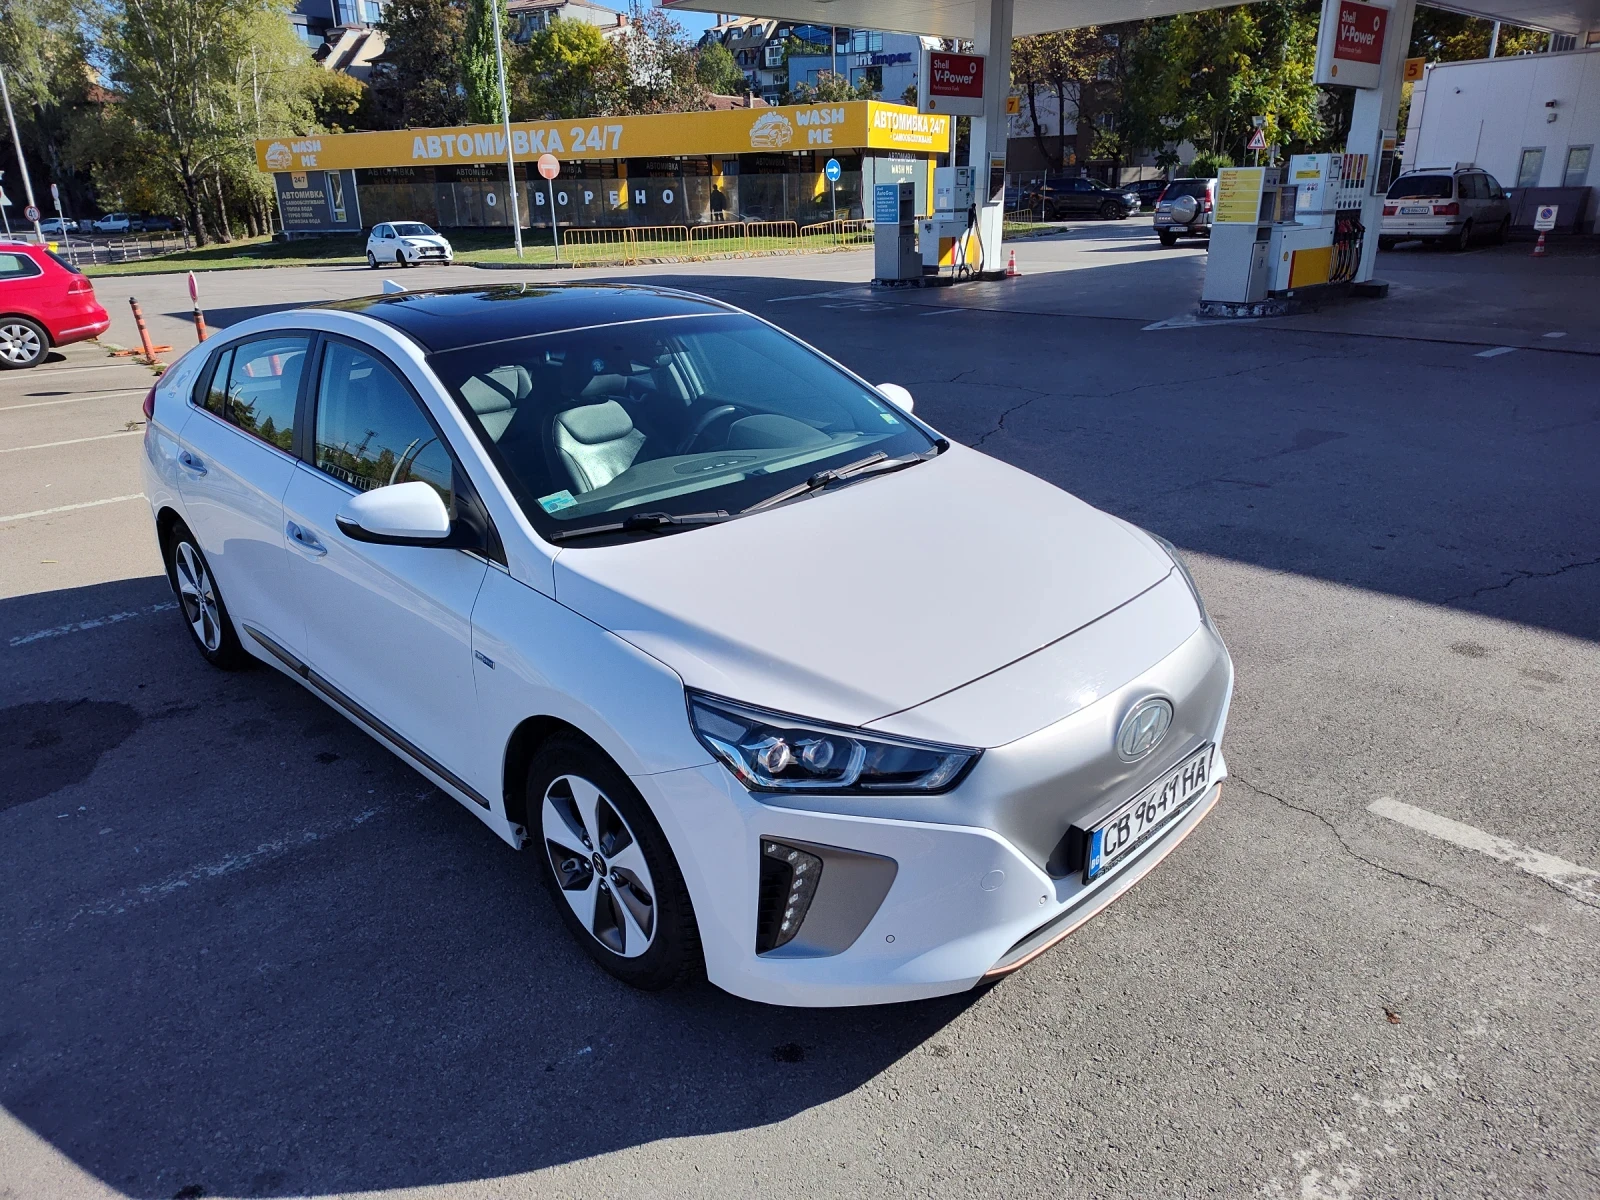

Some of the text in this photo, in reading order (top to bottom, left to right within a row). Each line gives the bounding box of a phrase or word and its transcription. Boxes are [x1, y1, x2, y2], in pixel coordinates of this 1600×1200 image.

[1342, 10, 1356, 23] Shell
[1341, 24, 1376, 45] V-Power
[934, 59, 950, 69] Shell
[1408, 64, 1418, 76] 5
[934, 70, 974, 84] V-Power
[1009, 101, 1014, 111] 7
[796, 108, 844, 126] WASH
[874, 110, 945, 134] АВТОМИВКА 24/7
[412, 125, 623, 159] АВТОМИВКА 24/7
[808, 128, 833, 144] ME
[291, 140, 321, 154] WASH
[301, 154, 317, 167] ME
[892, 164, 912, 174] WASH ME
[282, 191, 324, 199] АВТОМИВКА
[487, 190, 674, 206] ОВОРЕНО
[1104, 812, 1131, 856] CB
[1135, 774, 1179, 833] 9649
[1182, 756, 1205, 797] HA
[1091, 855, 1100, 870] BG
